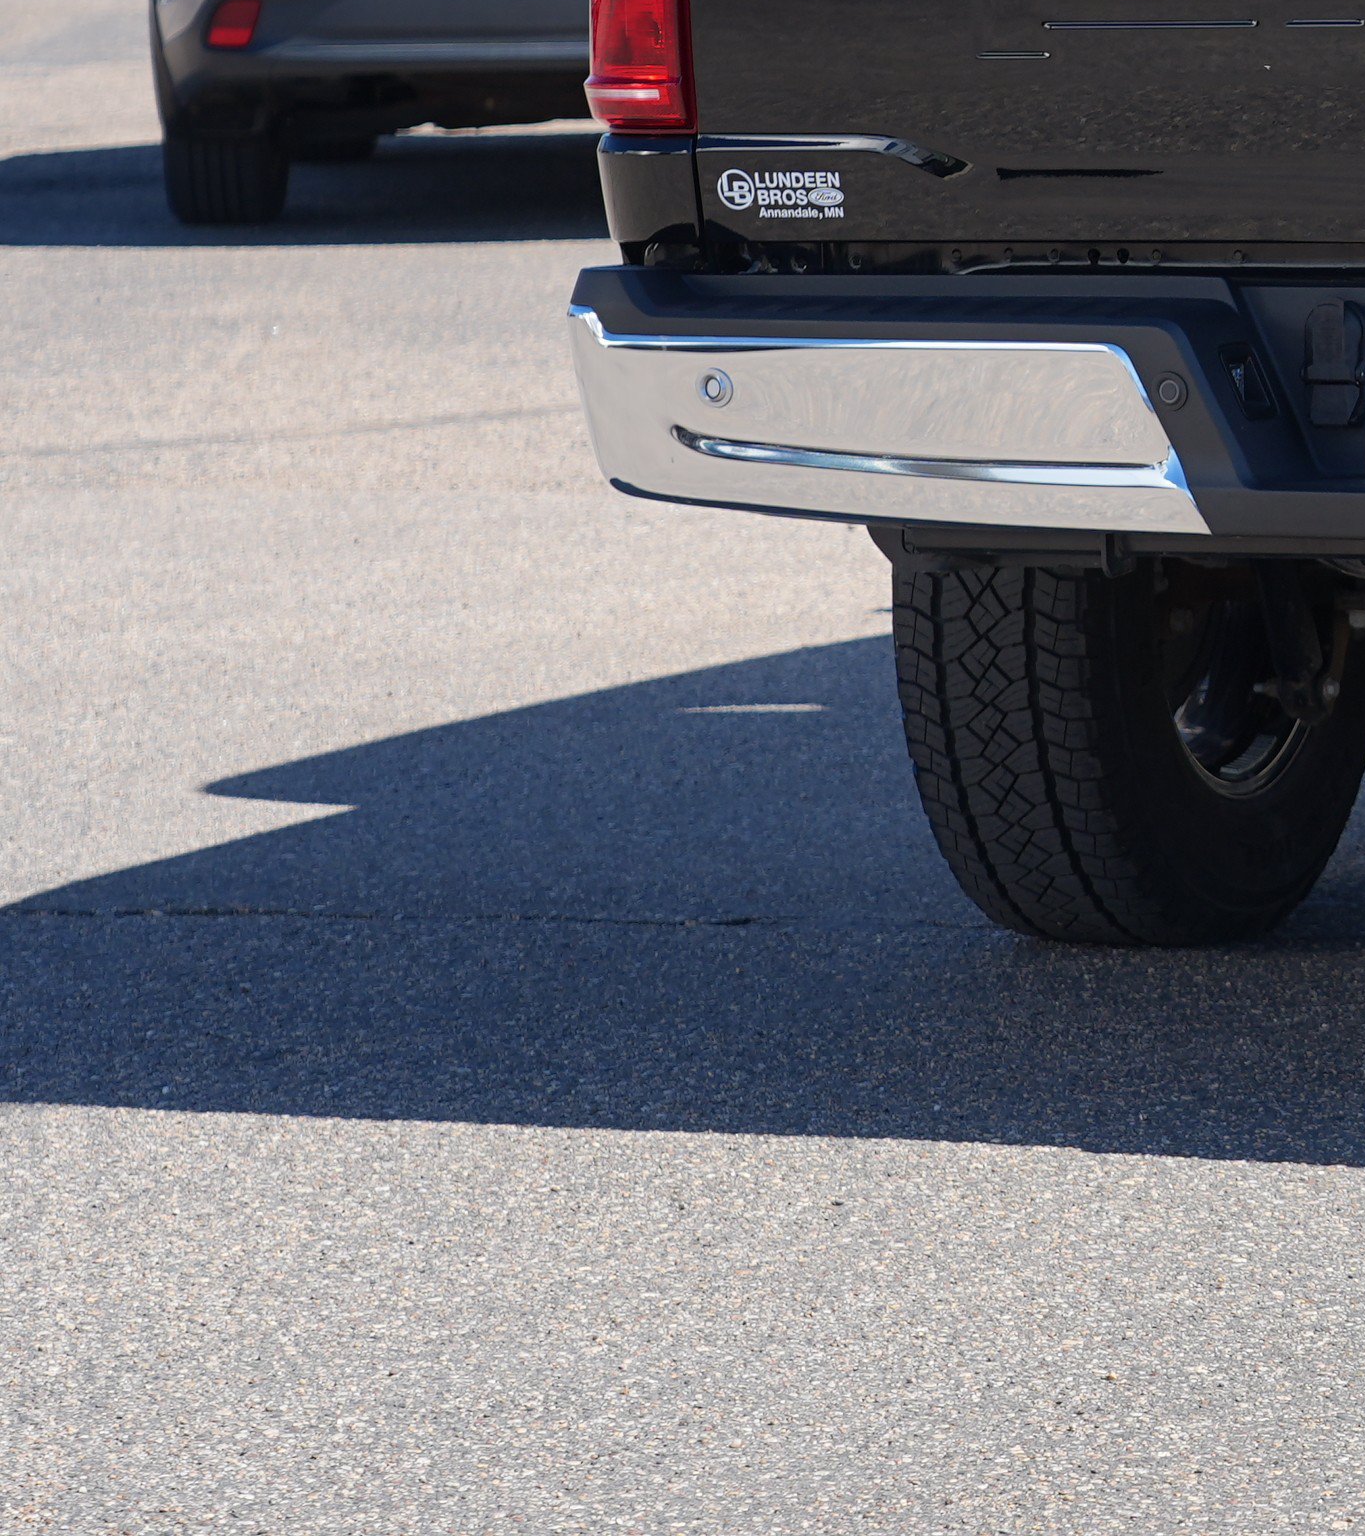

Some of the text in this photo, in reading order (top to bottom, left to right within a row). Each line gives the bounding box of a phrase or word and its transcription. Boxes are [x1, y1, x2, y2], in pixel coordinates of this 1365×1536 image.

[754, 171, 840, 188] LUNDEEN
[757, 189, 808, 205] BROS
[759, 207, 844, 220] Annandale, MN
